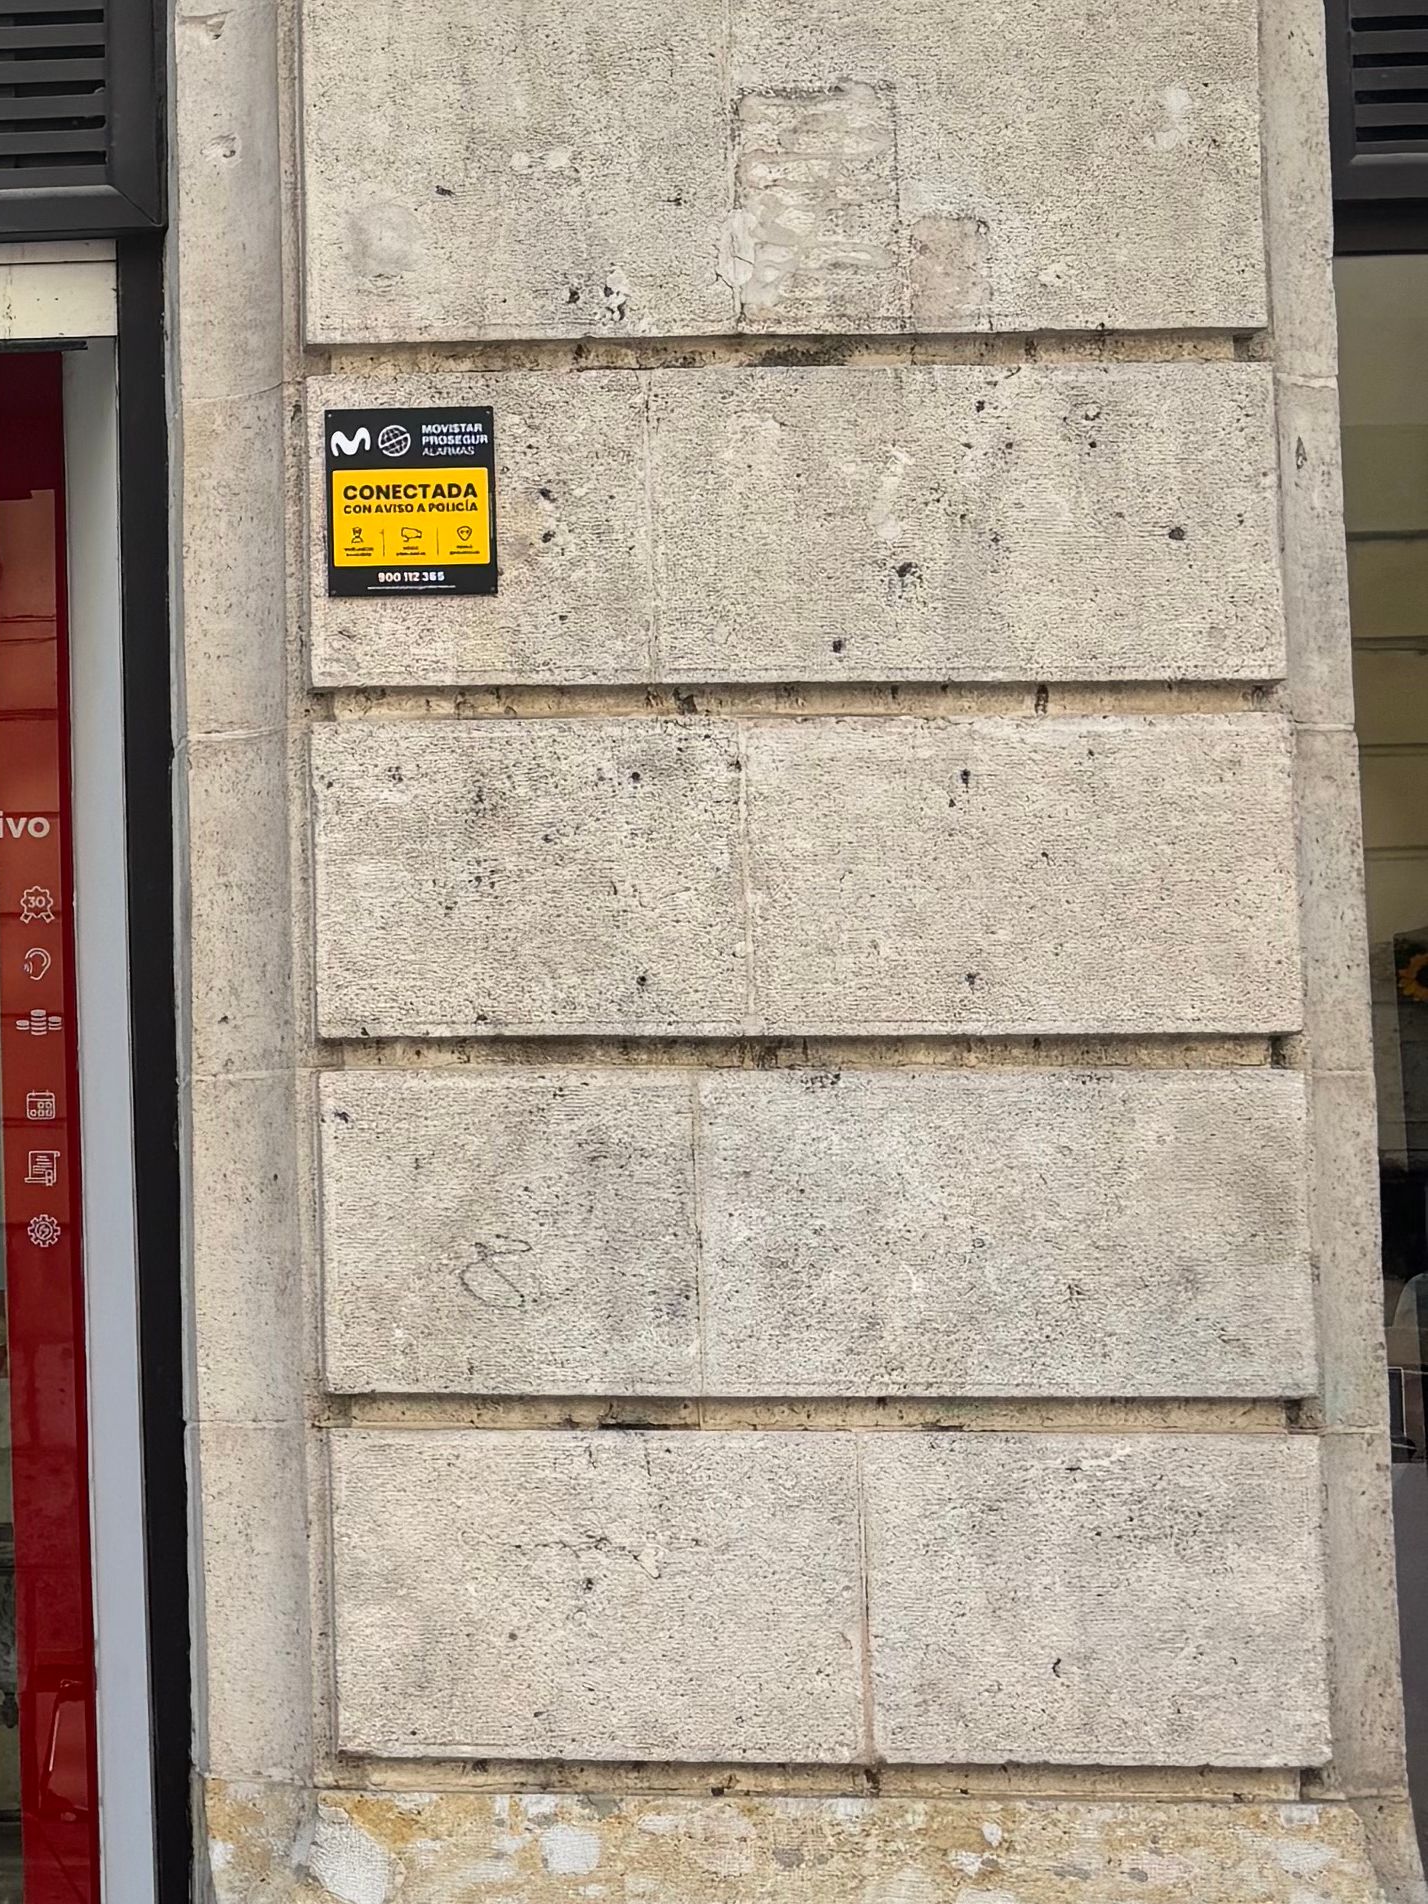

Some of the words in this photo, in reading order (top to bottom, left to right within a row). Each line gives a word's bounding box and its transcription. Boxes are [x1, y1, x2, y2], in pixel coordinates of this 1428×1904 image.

[422, 423, 482, 434] MOVISTAR
[422, 434, 488, 446] PROSEGUR
[422, 446, 475, 456] ALARMAS
[343, 483, 478, 500] CONECTADA
[343, 504, 372, 514] CON
[375, 502, 414, 514] AVISO
[417, 502, 426, 513] A
[428, 499, 478, 513] POLICÍA
[378, 572, 401, 583] 900
[404, 571, 420, 582] 112
[28, 896, 44, 908] 30
